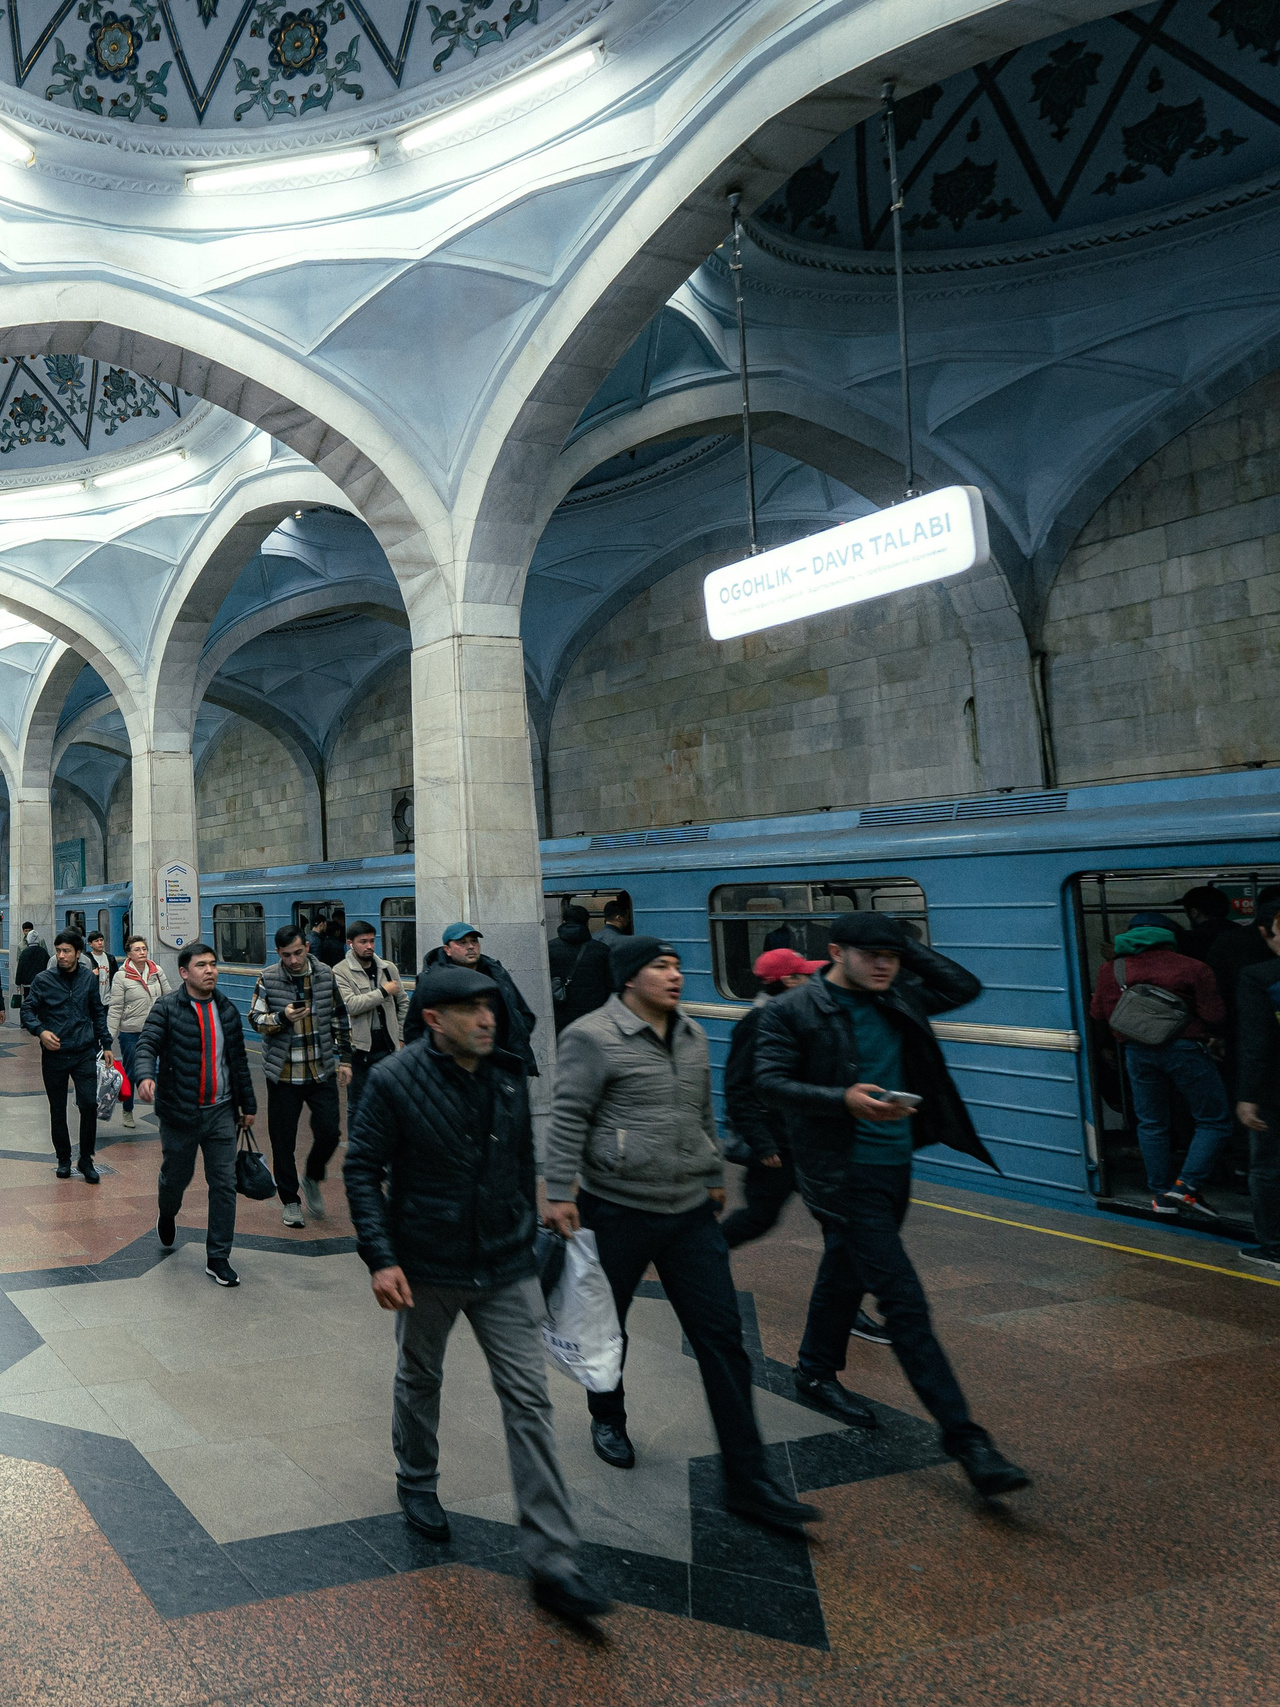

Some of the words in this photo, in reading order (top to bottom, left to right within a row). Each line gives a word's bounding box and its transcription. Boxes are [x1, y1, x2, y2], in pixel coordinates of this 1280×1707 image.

[719, 566, 792, 605] OGOHLIK
[812, 543, 865, 576] DAVR
[869, 512, 952, 556] TALABI
